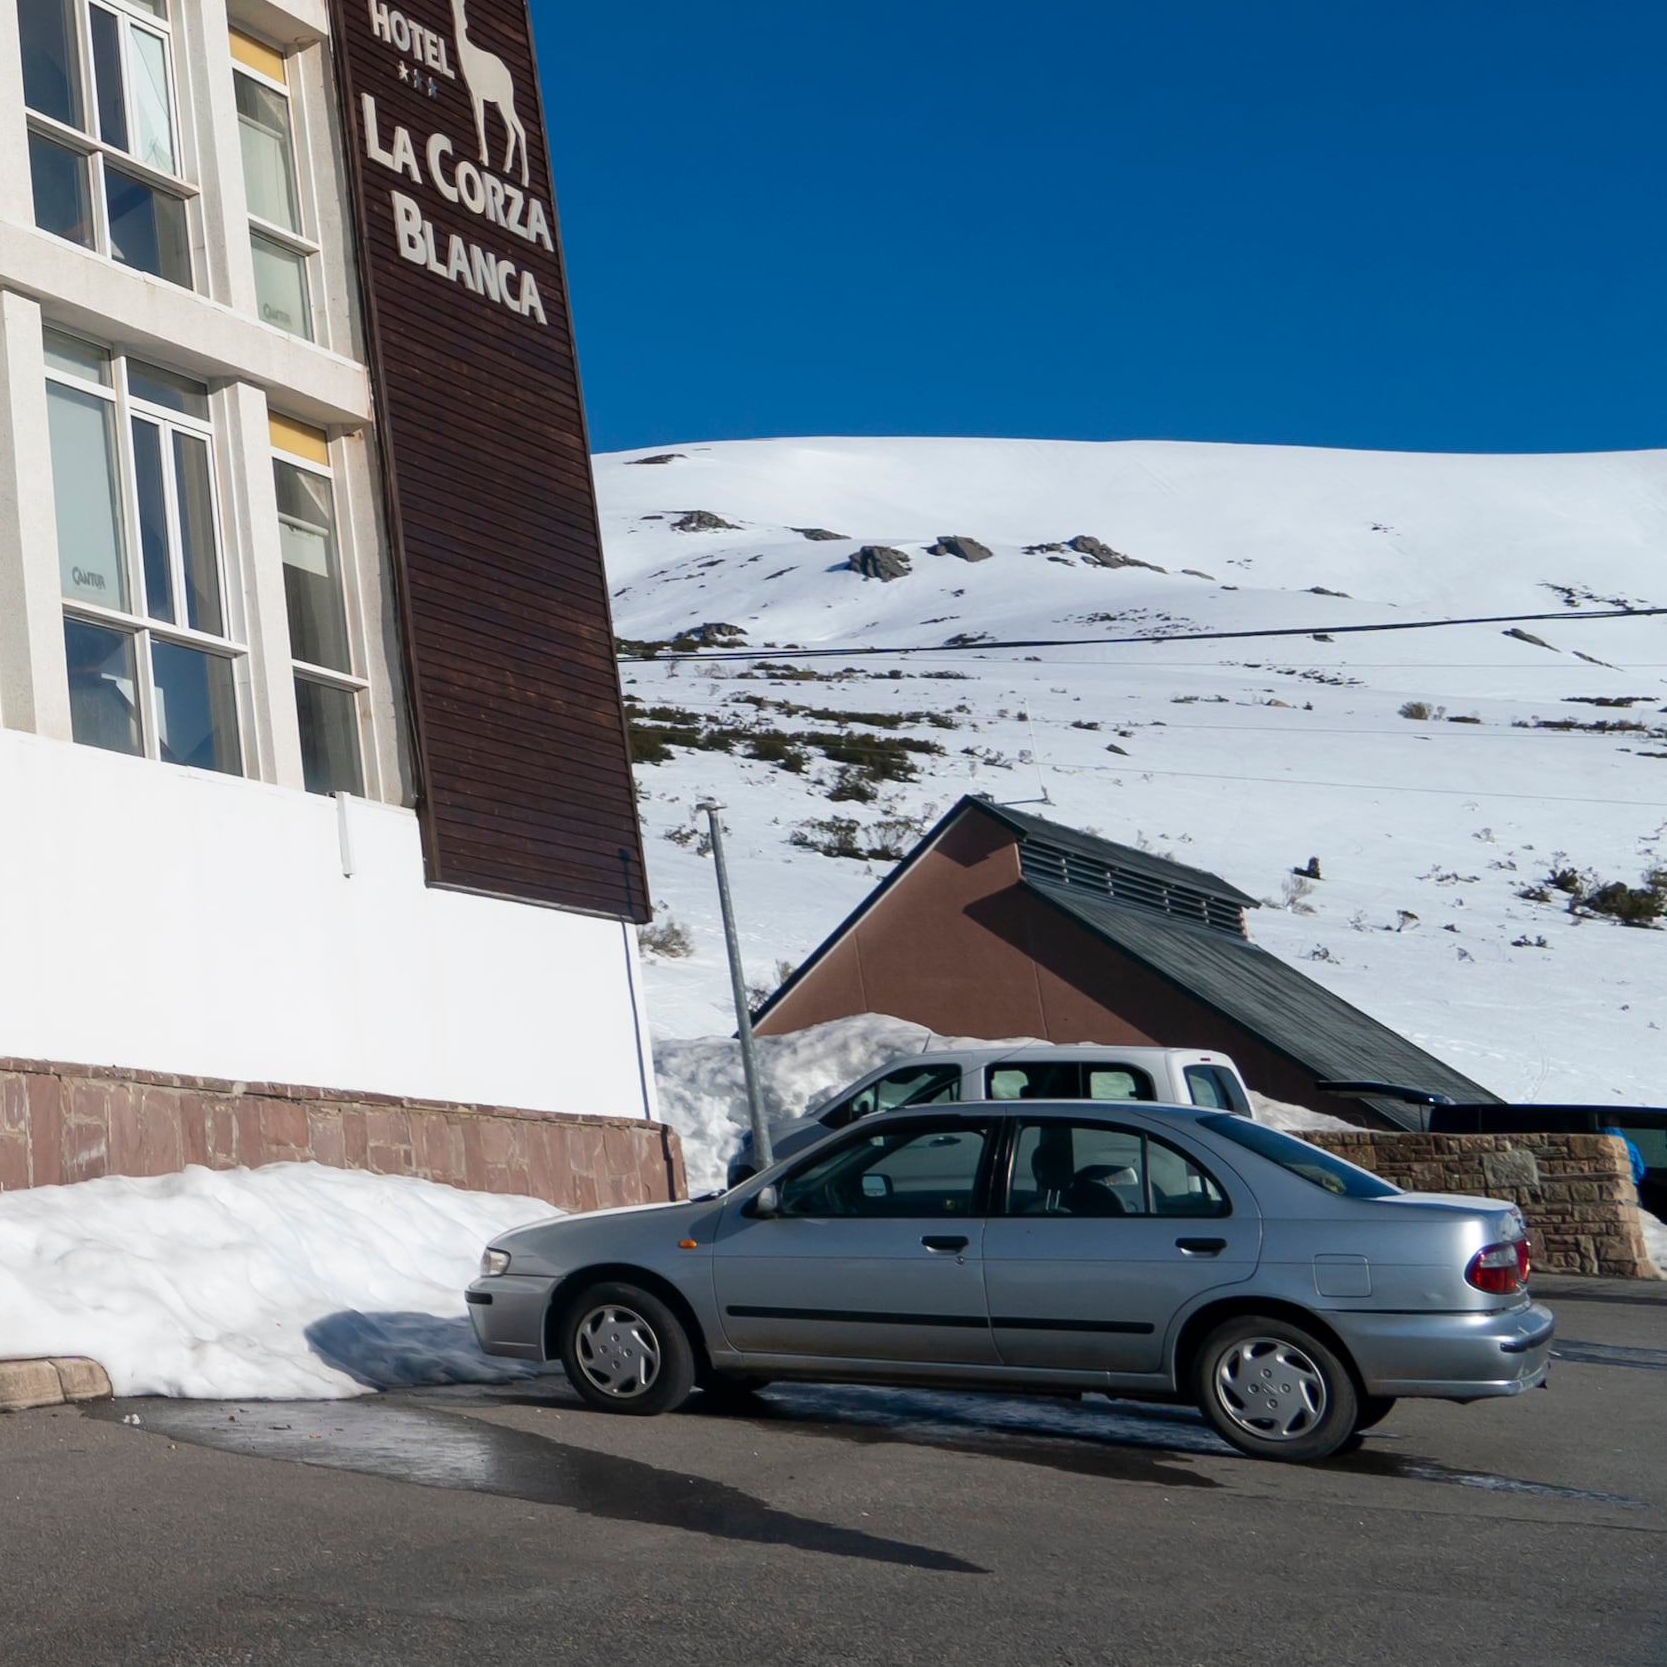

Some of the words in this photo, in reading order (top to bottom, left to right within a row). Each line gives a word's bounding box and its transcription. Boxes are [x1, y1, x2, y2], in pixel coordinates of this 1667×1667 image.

[361, 92, 422, 185] LA
[426, 133, 555, 253] CORZA
[390, 190, 548, 326] BLANCA
